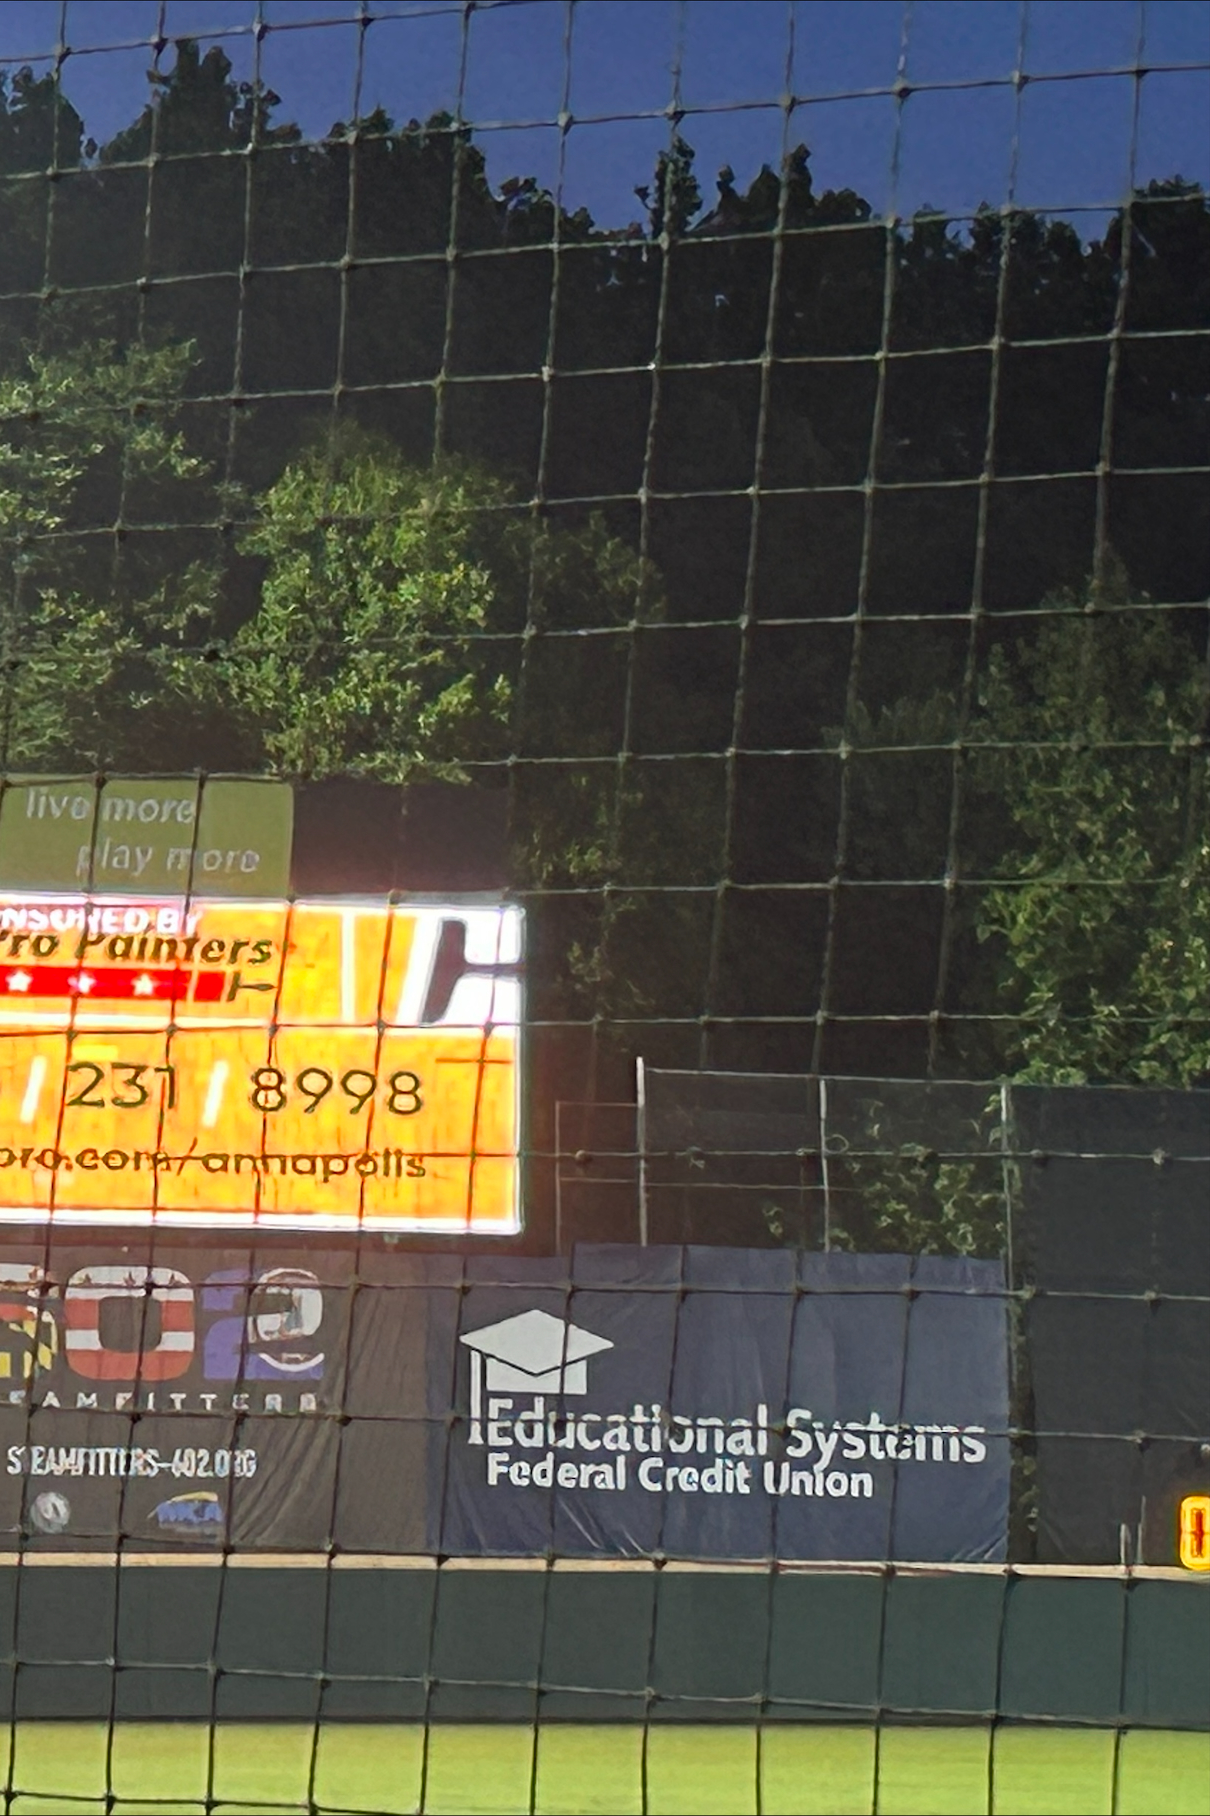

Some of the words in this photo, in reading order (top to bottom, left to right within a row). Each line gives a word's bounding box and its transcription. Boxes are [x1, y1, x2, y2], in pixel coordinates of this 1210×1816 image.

[26, 787, 89, 820] live
[101, 797, 196, 823] more
[76, 837, 153, 878] play
[166, 847, 261, 873] more
[156, 907, 203, 937] BY
[74, 930, 273, 965] Painters
[67, 1061, 176, 1109] 231
[251, 1067, 423, 1116] 8998
[487, 1396, 769, 1460] Educational
[785, 1409, 987, 1469] Systems
[487, 1451, 627, 1490] Federal
[638, 1456, 750, 1495] Credit
[764, 1459, 875, 1499] Union
